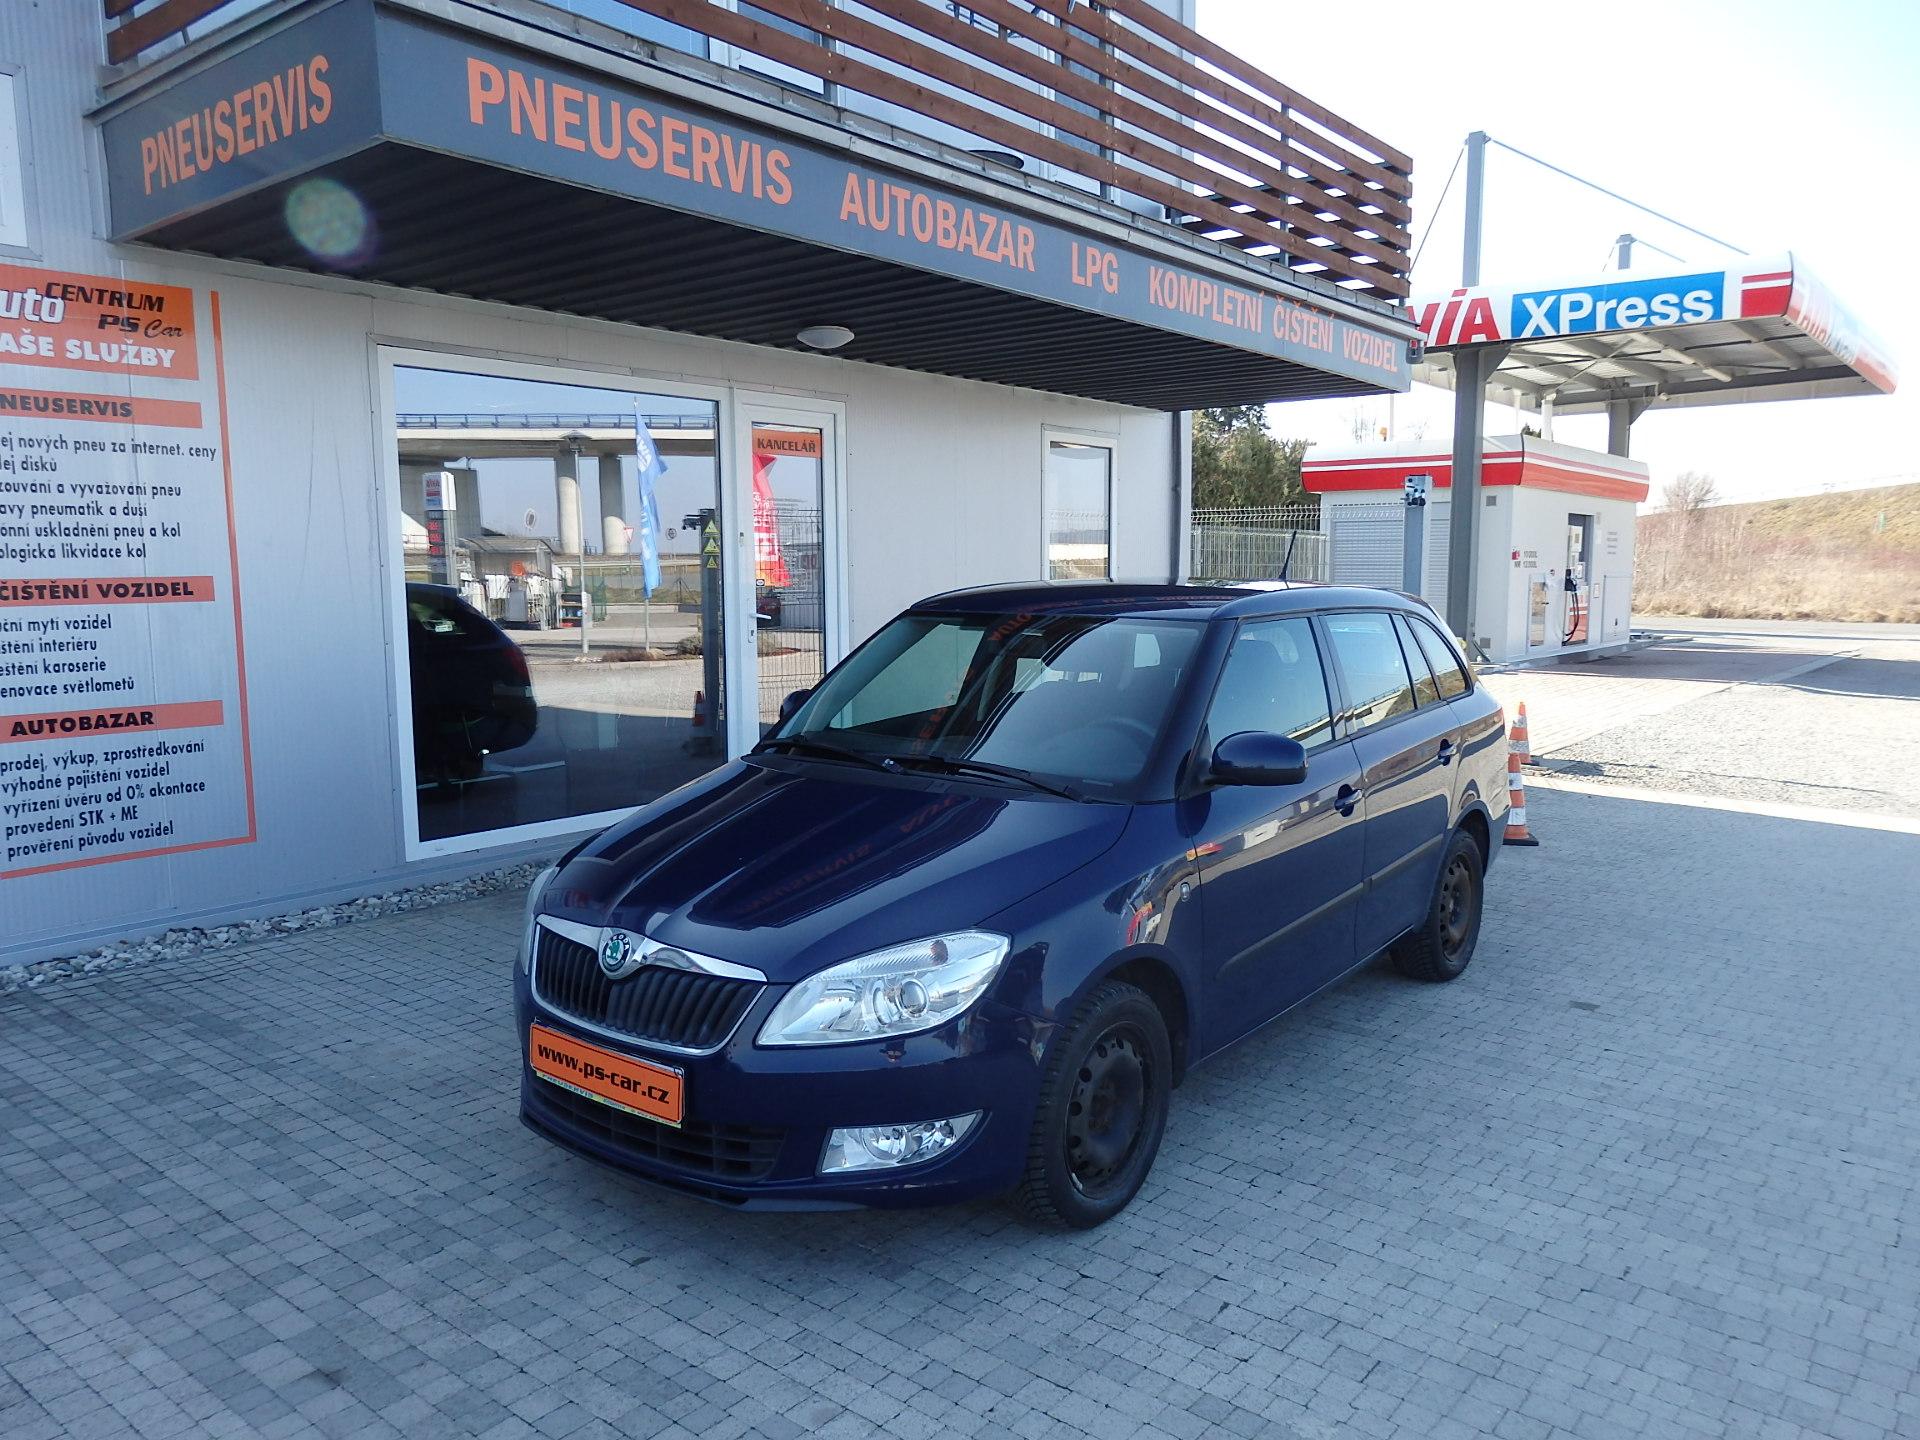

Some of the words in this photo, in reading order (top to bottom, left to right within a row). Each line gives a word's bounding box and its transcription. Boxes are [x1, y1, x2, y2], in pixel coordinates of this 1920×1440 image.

[141, 54, 332, 195] PNEUSERVIS
[467, 57, 793, 205] PNEUSERVIS
[840, 172, 1035, 272] AUTOBAZAR
[1071, 241, 1119, 294] LPG
[46, 282, 165, 313] CENTRUM
[98, 314, 141, 333] PS
[144, 319, 184, 338] Car
[1150, 266, 1264, 333] KOMPLETNÍ
[1273, 295, 1335, 353] ČIŠTĚNÍ
[1343, 327, 1398, 373] VOZIDEL
[1520, 289, 1715, 340] XPress
[65, 337, 176, 369] SLUŽBY
[18, 434, 69, 453] nových
[73, 440, 106, 454] pneu
[111, 442, 126, 453] za
[189, 446, 217, 461] ceny
[757, 439, 816, 453] KANCELÁŘ
[57, 483, 65, 494] a
[70, 481, 148, 498] vyvažování
[151, 485, 181, 500] pneu
[31, 500, 104, 519] pneumatik
[109, 505, 117, 516] a
[35, 521, 109, 538] uskladnění
[113, 526, 145, 540] pneu
[149, 527, 157, 538] a
[162, 522, 181, 537] kol
[61, 542, 122, 559] likvidace
[127, 542, 147, 558] kol
[96, 581, 194, 599] VOZIDEL
[64, 613, 112, 631] vozidel
[39, 637, 97, 653] interiéru
[43, 658, 107, 675] karoserie
[63, 676, 135, 695] světlometů
[10, 711, 154, 737] AUTOBAZAR
[104, 739, 205, 765] zprostředkování
[2, 774, 62, 797] výhodné
[67, 769, 121, 791] pojištění
[126, 761, 170, 780] vozidel
[4, 797, 60, 818] vyřízení
[65, 793, 102, 808] úvěru
[106, 786, 122, 803] od
[126, 783, 145, 800] 0%
[149, 781, 206, 798] akontace
[6, 816, 75, 841] provedení
[79, 809, 105, 827] STK
[121, 805, 138, 822] ME
[8, 835, 74, 862] prověření
[78, 827, 125, 851] původu
[129, 820, 174, 840] vozidel
[537, 1042, 671, 1105] www.ps-car.cz
